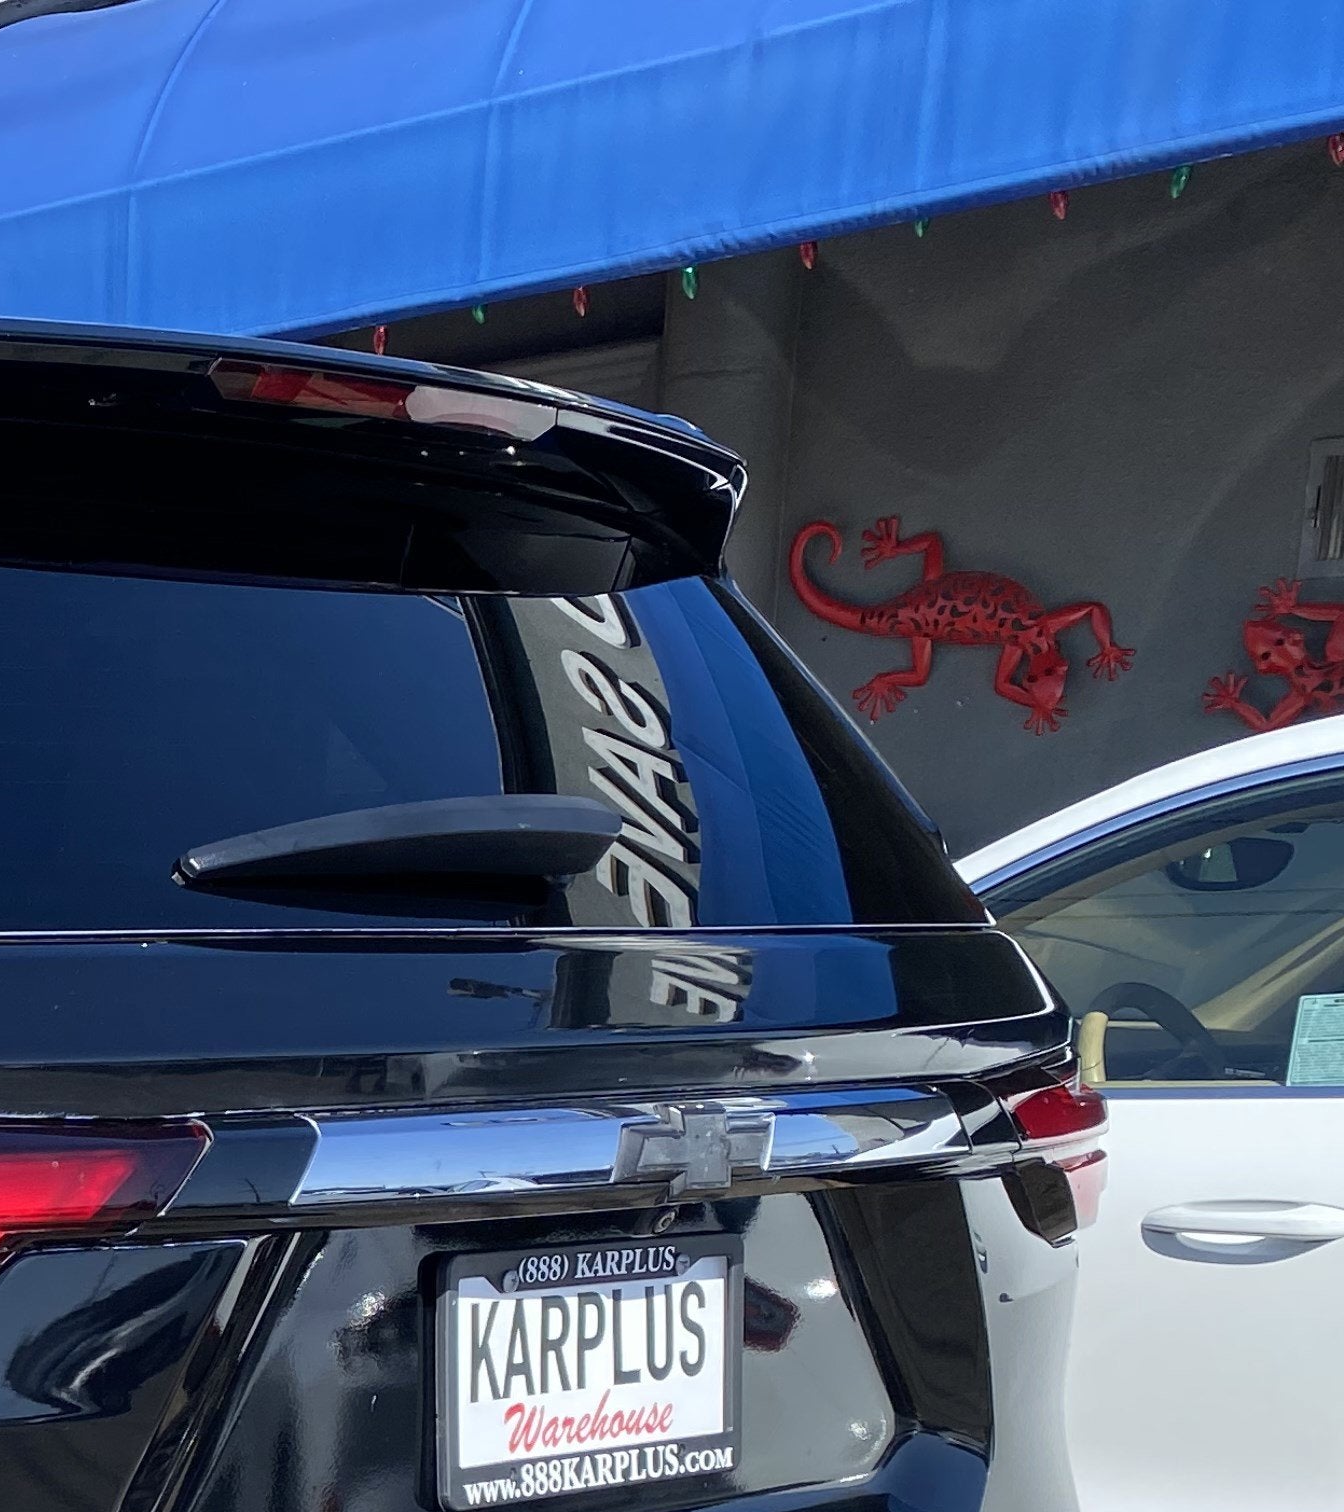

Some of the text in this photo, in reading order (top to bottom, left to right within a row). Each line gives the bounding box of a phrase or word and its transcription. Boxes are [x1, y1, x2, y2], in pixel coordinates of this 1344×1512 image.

[518, 1246, 677, 1284] (888) KARPLUS
[470, 1281, 706, 1403] KARPLUS
[504, 1388, 674, 1454] Warehouse
